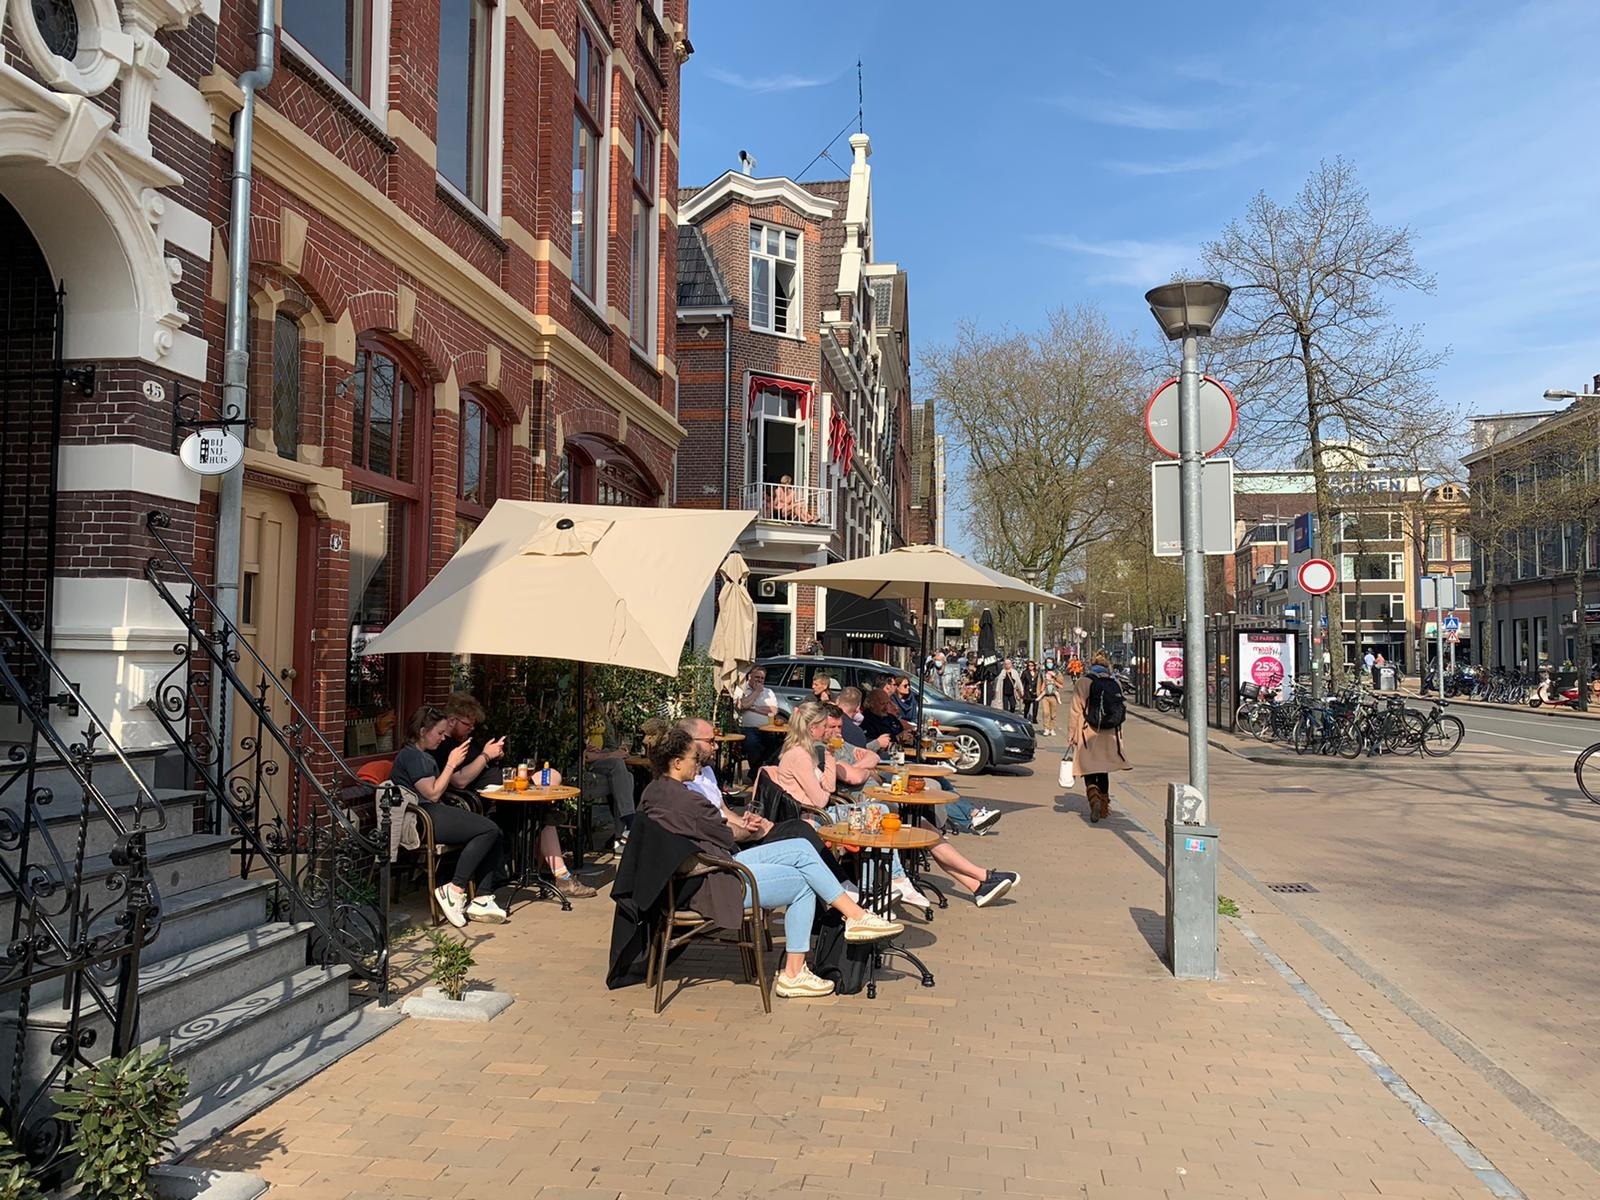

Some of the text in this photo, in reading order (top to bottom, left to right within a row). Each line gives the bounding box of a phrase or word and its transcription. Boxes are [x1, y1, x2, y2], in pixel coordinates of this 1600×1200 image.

[146, 383, 162, 398] 45
[210, 438, 224, 447] BIJ
[209, 456, 228, 464] HUIS
[1255, 661, 1280, 671] 25%
